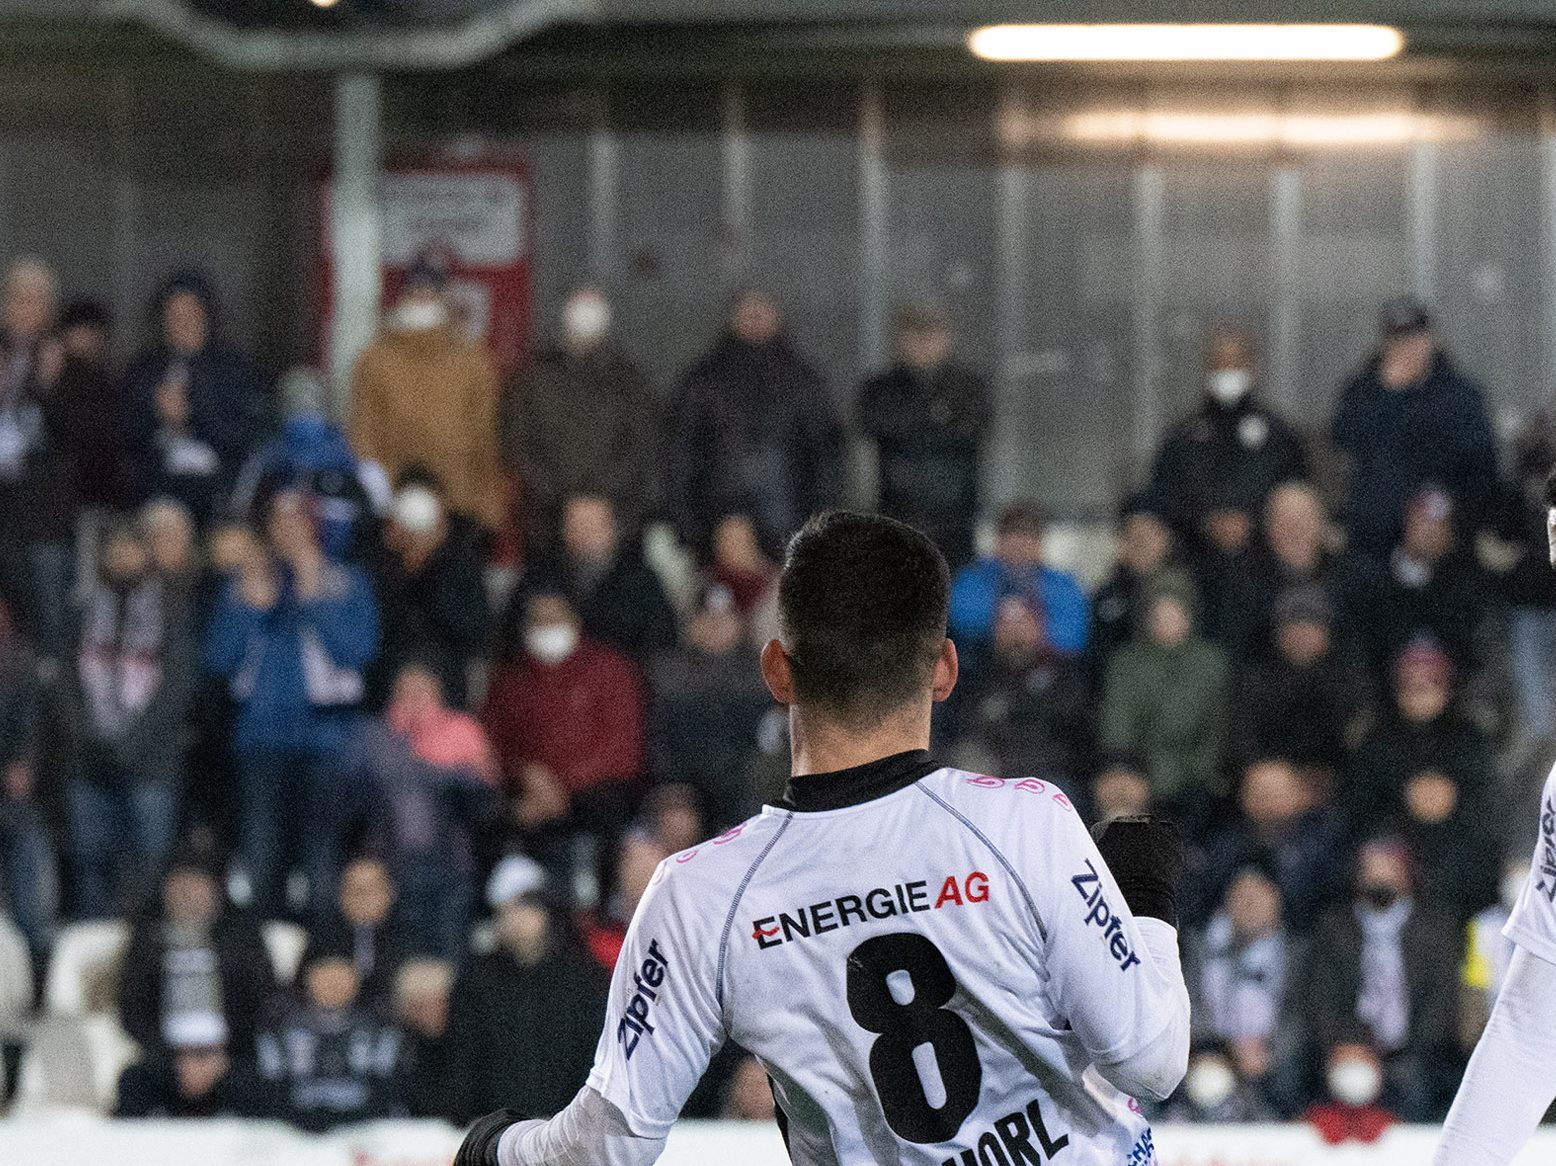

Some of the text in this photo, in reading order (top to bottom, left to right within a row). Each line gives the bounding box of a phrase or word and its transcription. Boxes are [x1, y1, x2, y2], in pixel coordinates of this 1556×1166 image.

[752, 871, 990, 950] ENERGIE AG
[1070, 858, 1141, 972] Zipfer
[617, 938, 669, 1060] Zipfer
[846, 932, 983, 1145] 8
